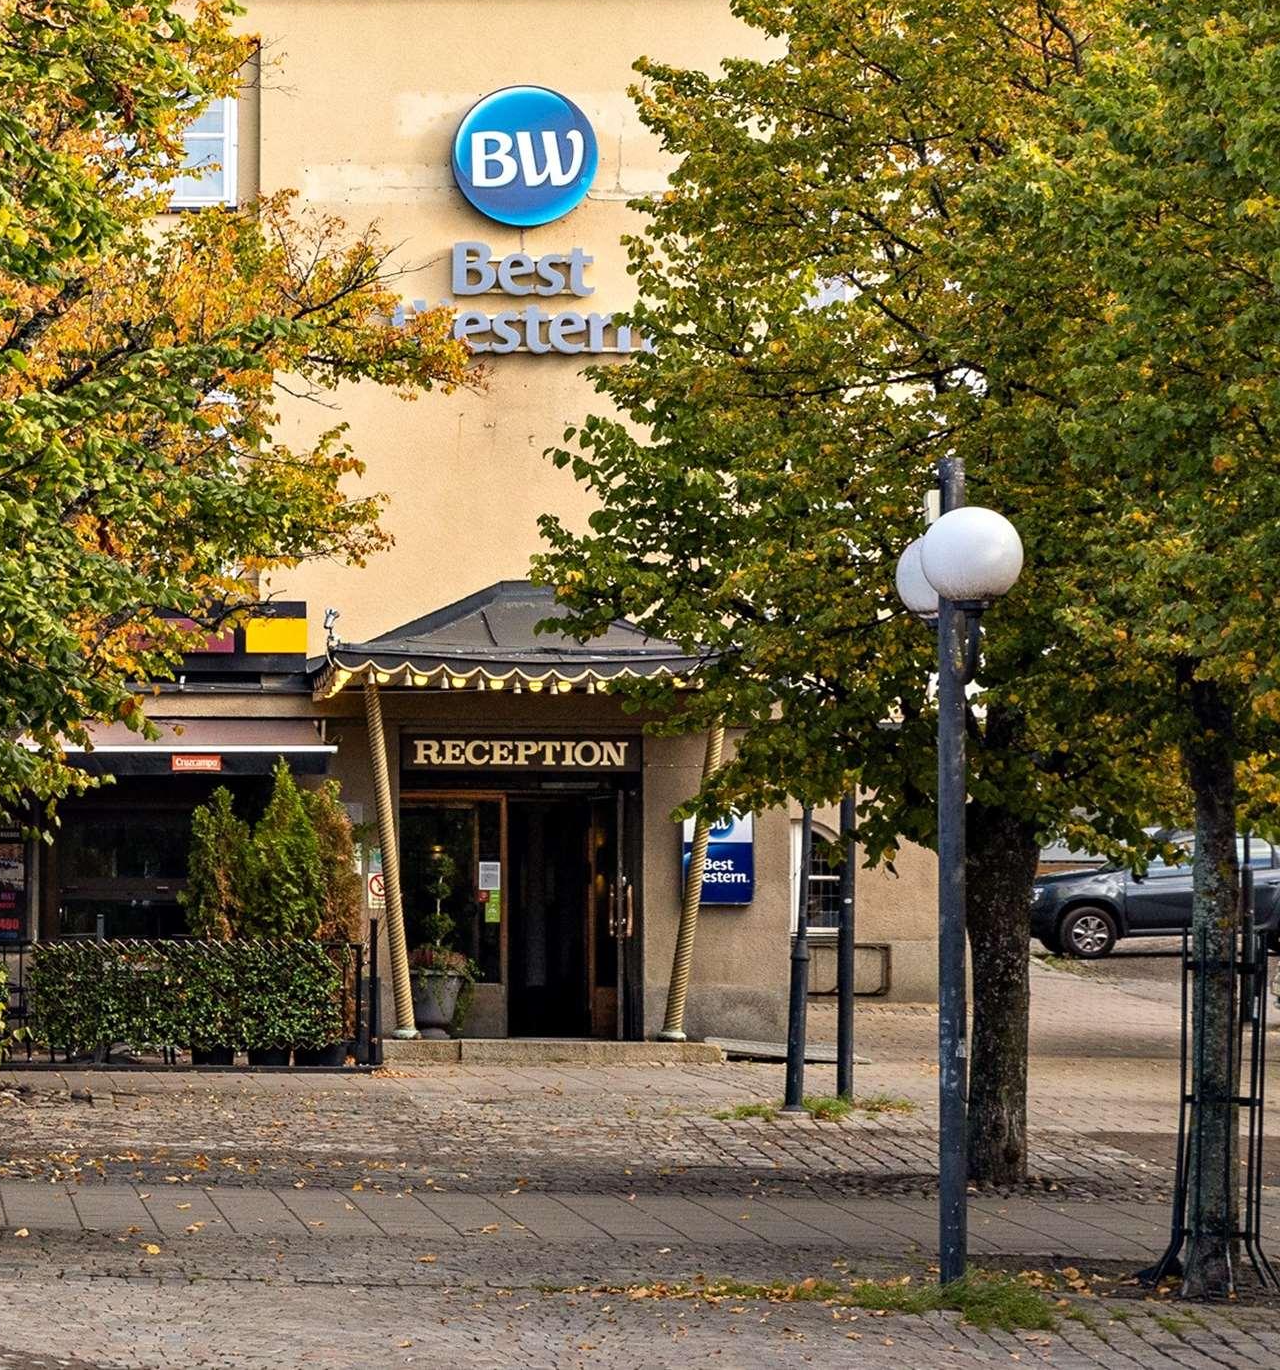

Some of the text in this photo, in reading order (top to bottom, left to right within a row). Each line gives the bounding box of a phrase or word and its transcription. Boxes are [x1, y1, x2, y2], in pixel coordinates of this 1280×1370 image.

[471, 129, 584, 188] BW
[452, 240, 595, 297] Best
[413, 739, 629, 766] RECEPTION
[703, 872, 747, 883] estern
[704, 859, 734, 870] Best
